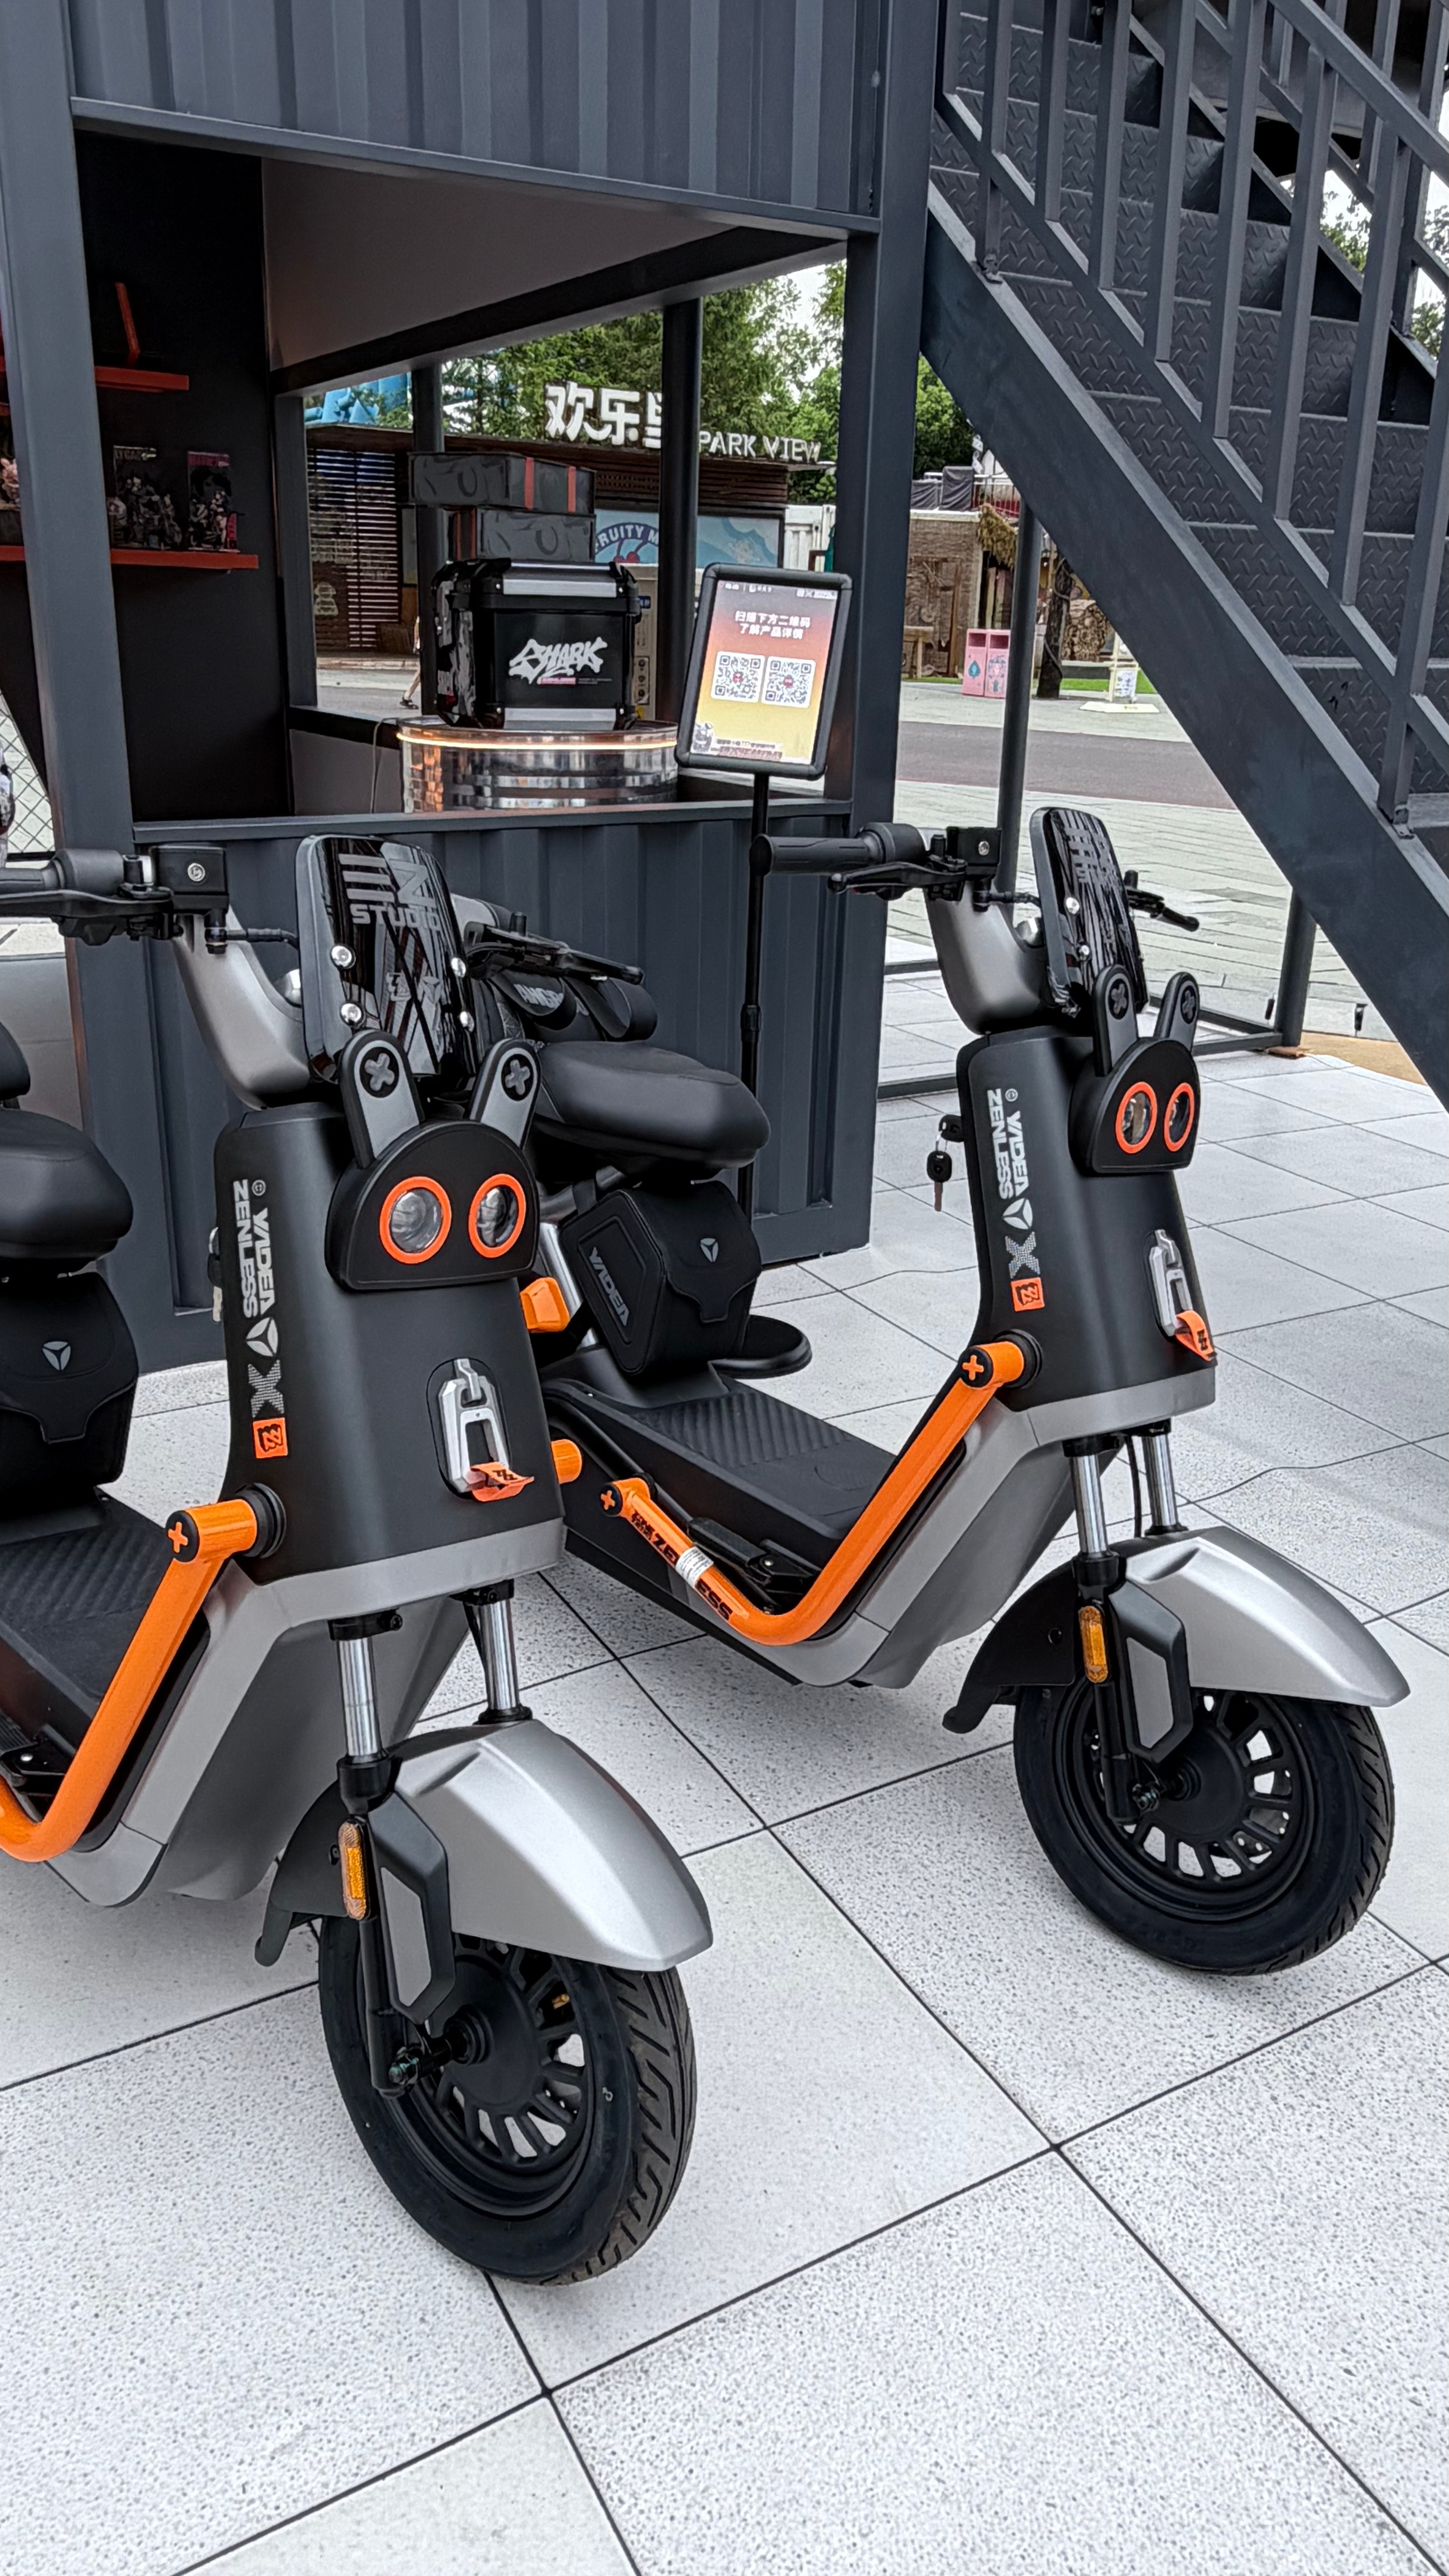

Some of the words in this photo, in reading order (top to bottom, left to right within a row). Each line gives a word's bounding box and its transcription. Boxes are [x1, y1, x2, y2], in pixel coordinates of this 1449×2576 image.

[699, 432, 756, 458] PARK
[764, 436, 822, 462] VIEW
[350, 903, 442, 932] STUDIO
[987, 1088, 1013, 1200] ZENLESS
[1007, 1110, 1030, 1197] YADEA
[233, 1179, 258, 1319] ZENLESS
[252, 1207, 275, 1315] YADEA
[589, 1247, 630, 1327] YADEA
